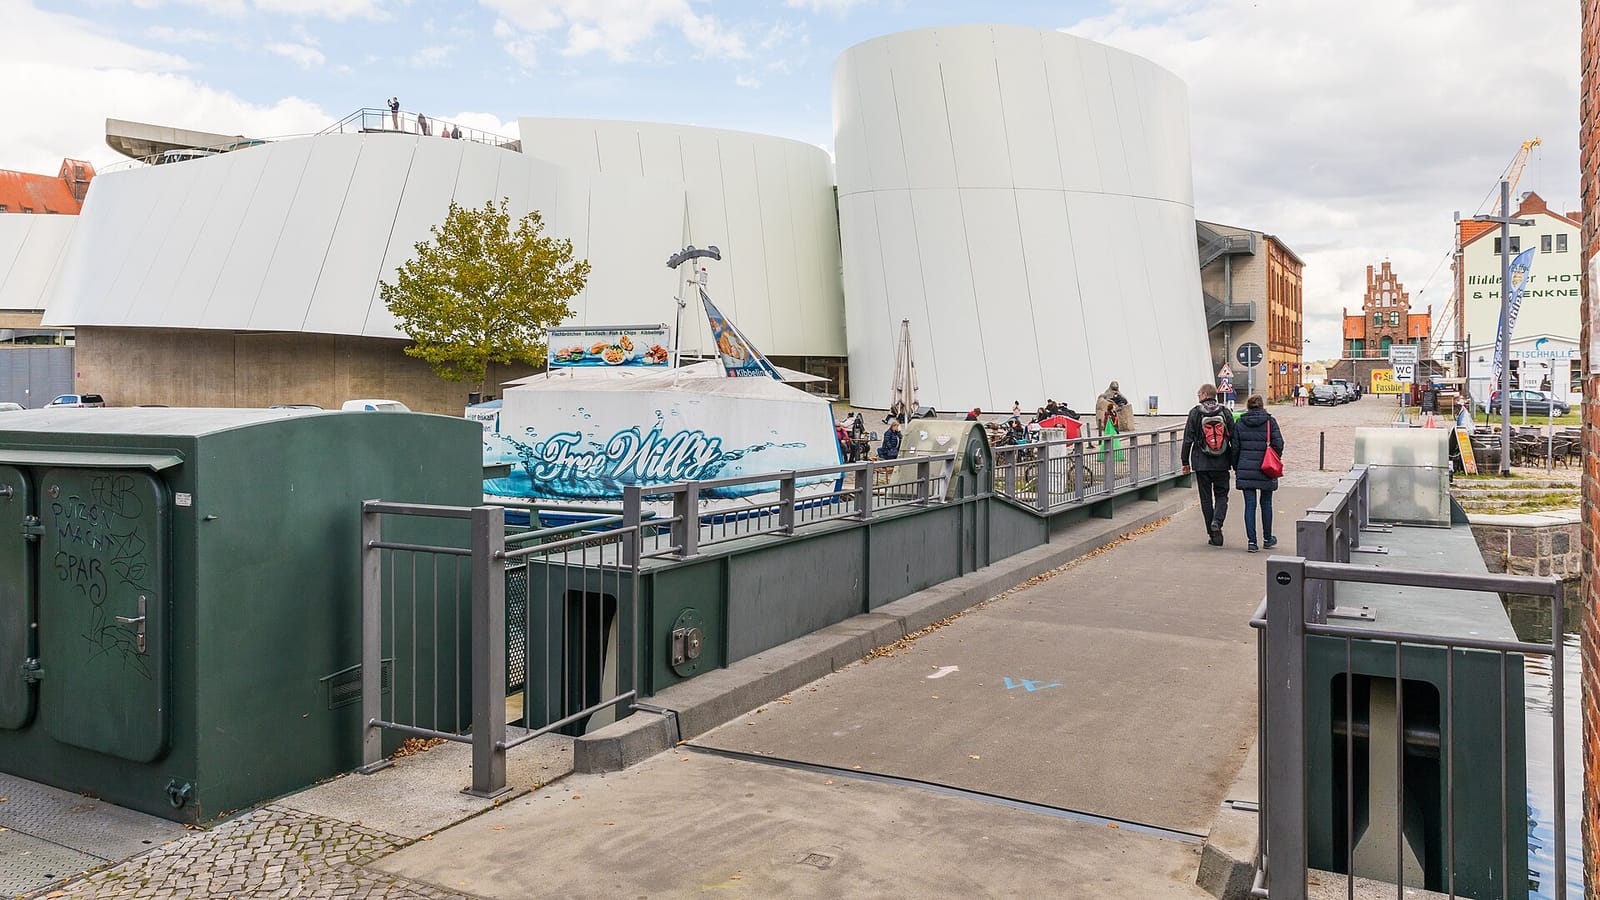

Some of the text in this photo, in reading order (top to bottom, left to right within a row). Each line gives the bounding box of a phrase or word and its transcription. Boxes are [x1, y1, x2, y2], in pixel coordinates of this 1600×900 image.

[1547, 274, 1582, 282] HOT
[1473, 291, 1482, 299] &
[1395, 366, 1412, 374] WC
[1376, 384, 1402, 392] Fassbie
[536, 427, 723, 482] Free Willy
